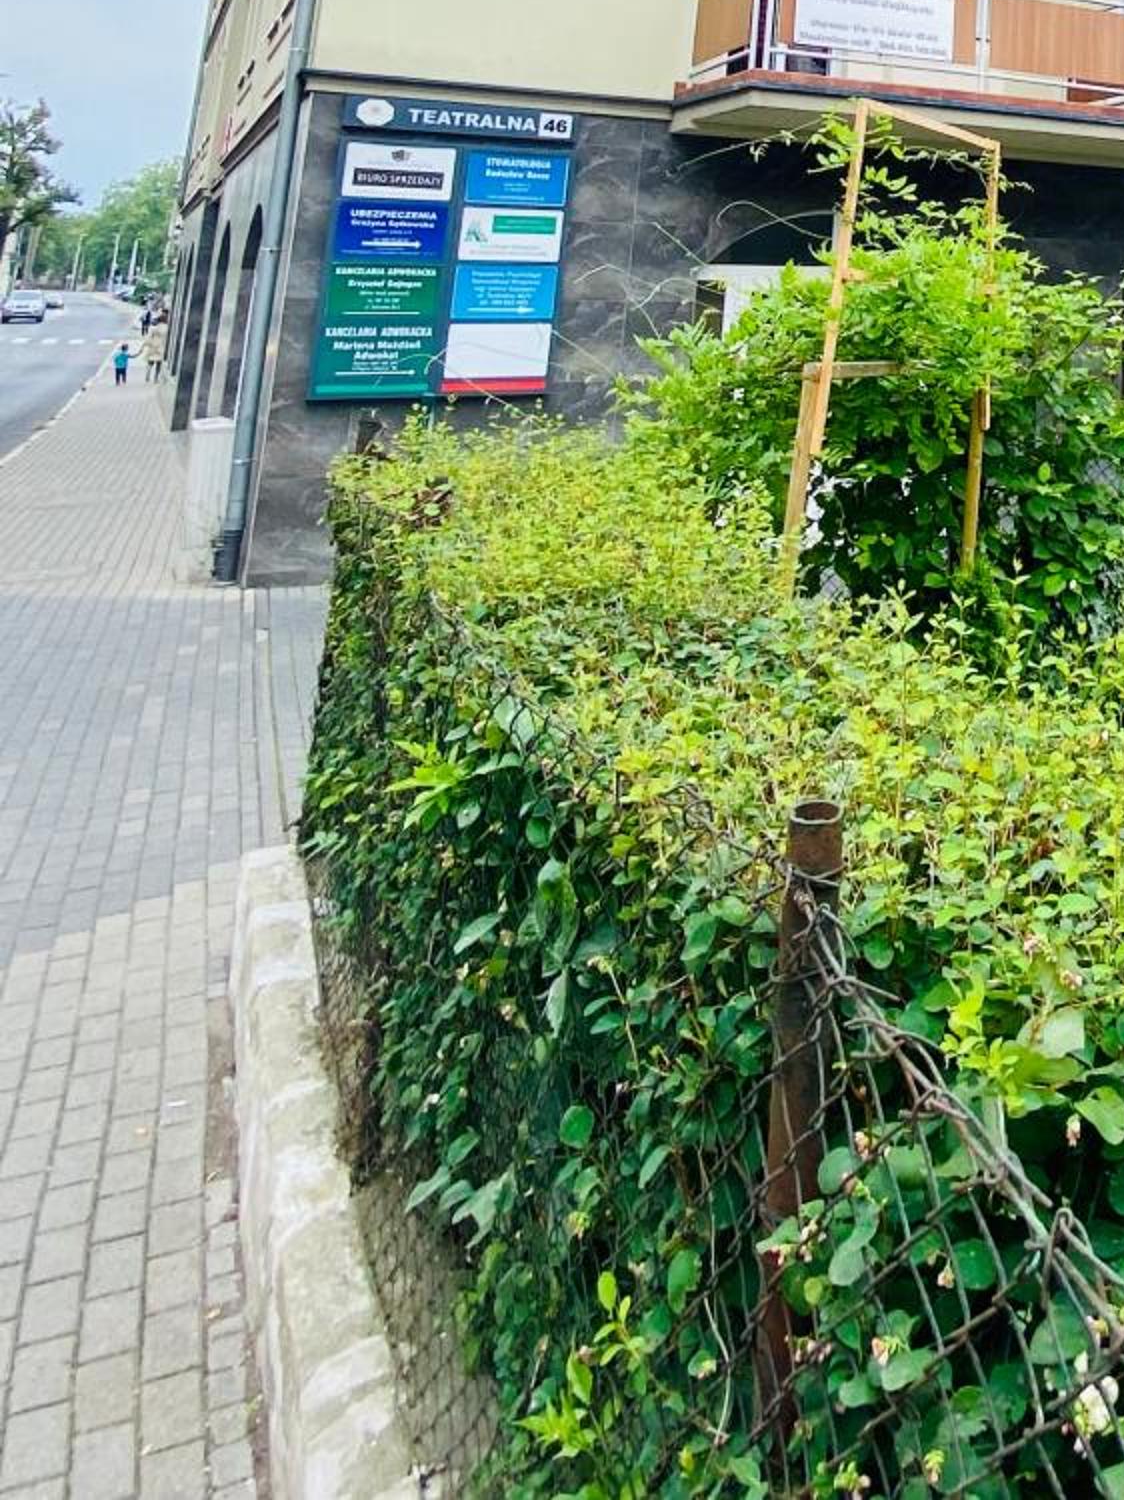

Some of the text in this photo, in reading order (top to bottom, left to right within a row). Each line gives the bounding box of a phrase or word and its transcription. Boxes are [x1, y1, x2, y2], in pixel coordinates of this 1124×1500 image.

[409, 107, 568, 134] TEATRALNA 46
[356, 172, 387, 184] BIURO
[349, 209, 438, 221] UBEZPIECZENIA
[335, 267, 438, 277] KANCELARIA ADWOKACKA
[325, 326, 433, 338] KANCELARIA ADWOKACKA
[353, 350, 399, 360] Adwokat
